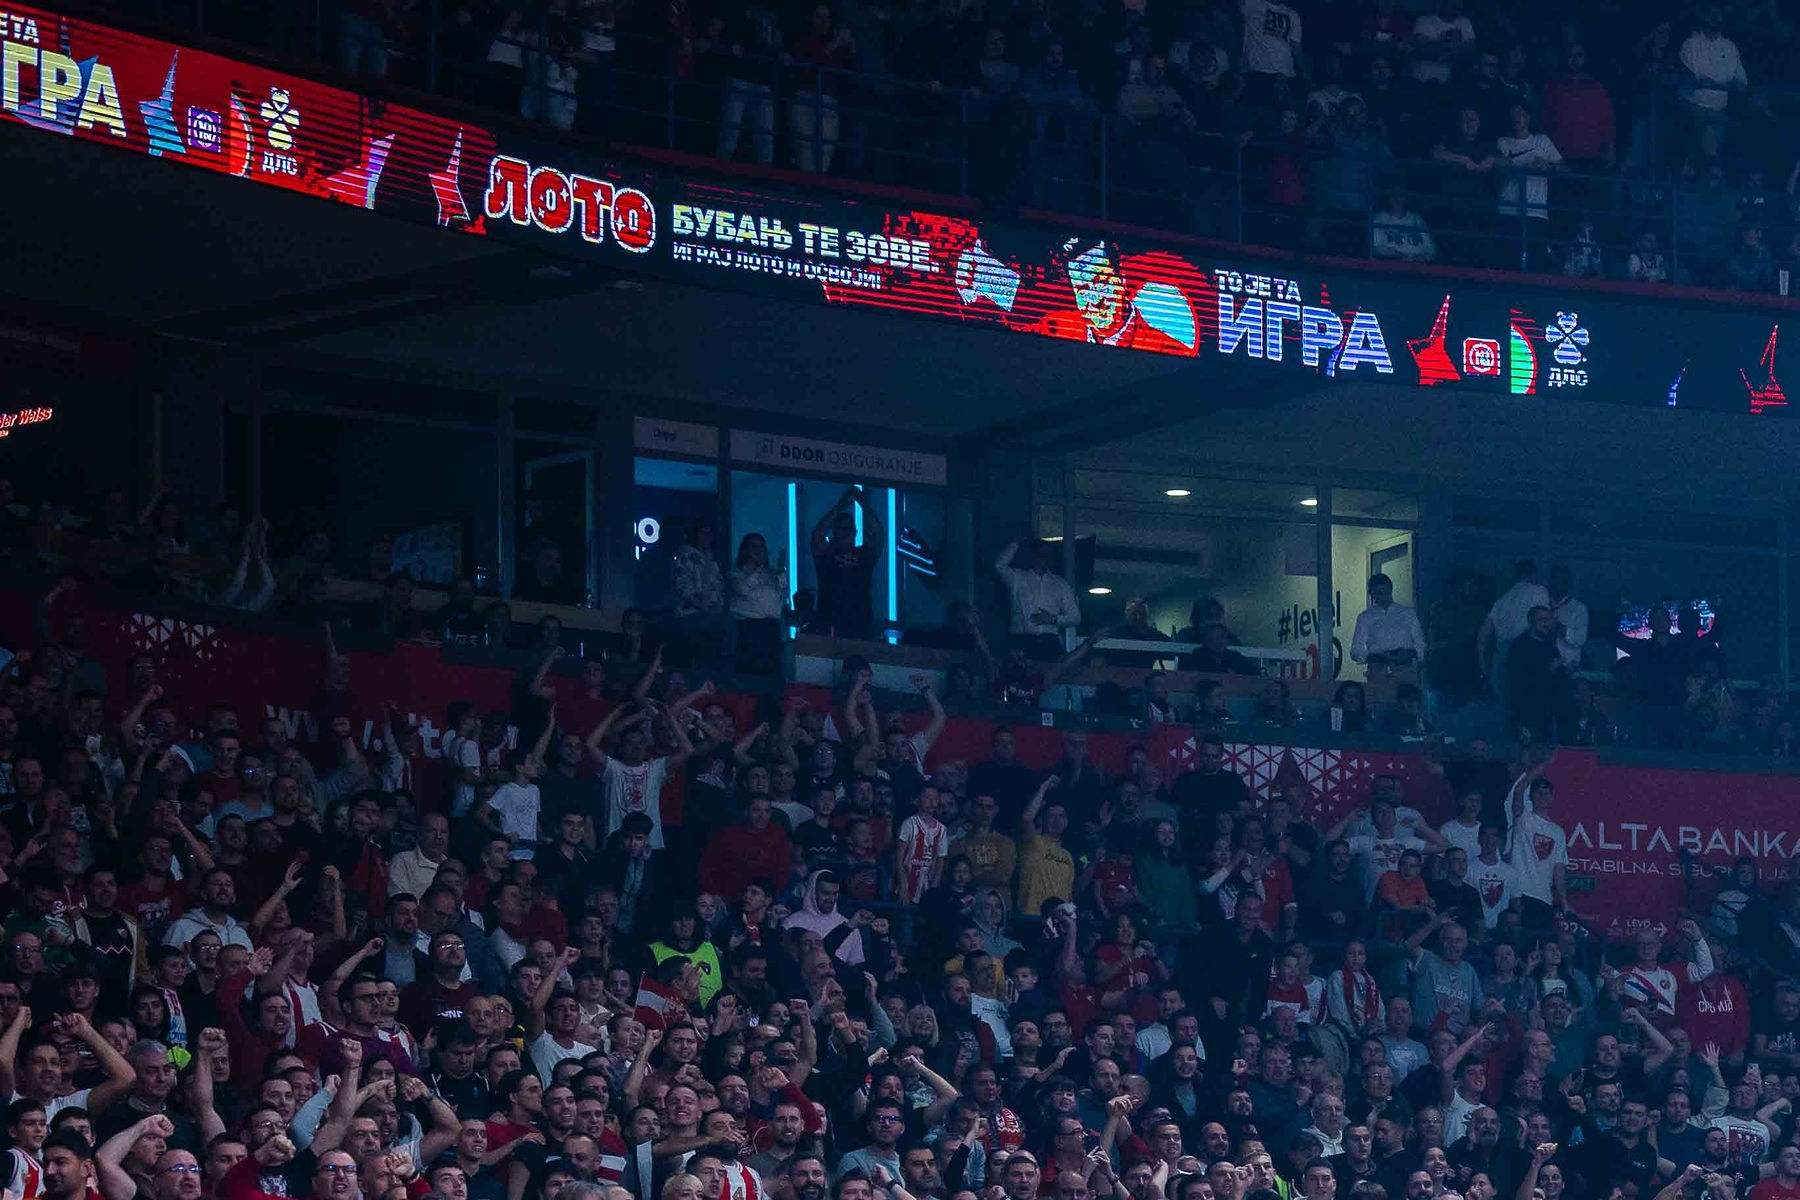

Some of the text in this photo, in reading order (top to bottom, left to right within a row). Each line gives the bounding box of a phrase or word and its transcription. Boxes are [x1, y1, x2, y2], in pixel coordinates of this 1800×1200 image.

[2, 40, 127, 138] ГРА
[261, 151, 298, 176] ДЛС
[485, 155, 656, 253] ЛОТО
[673, 204, 939, 273] БУБАЊ ТЕ ЗОВЕ.
[673, 242, 732, 267] ИГРАЈ
[735, 252, 784, 274] ЛОТО
[787, 261, 801, 278] И
[1214, 270, 1243, 292] ТО
[1274, 278, 1302, 302] ТА
[1218, 293, 1394, 375] ИГРА
[1548, 368, 1588, 387] ДЛС
[780, 442, 825, 464] DDOR
[1277, 590, 1342, 645] #levl
